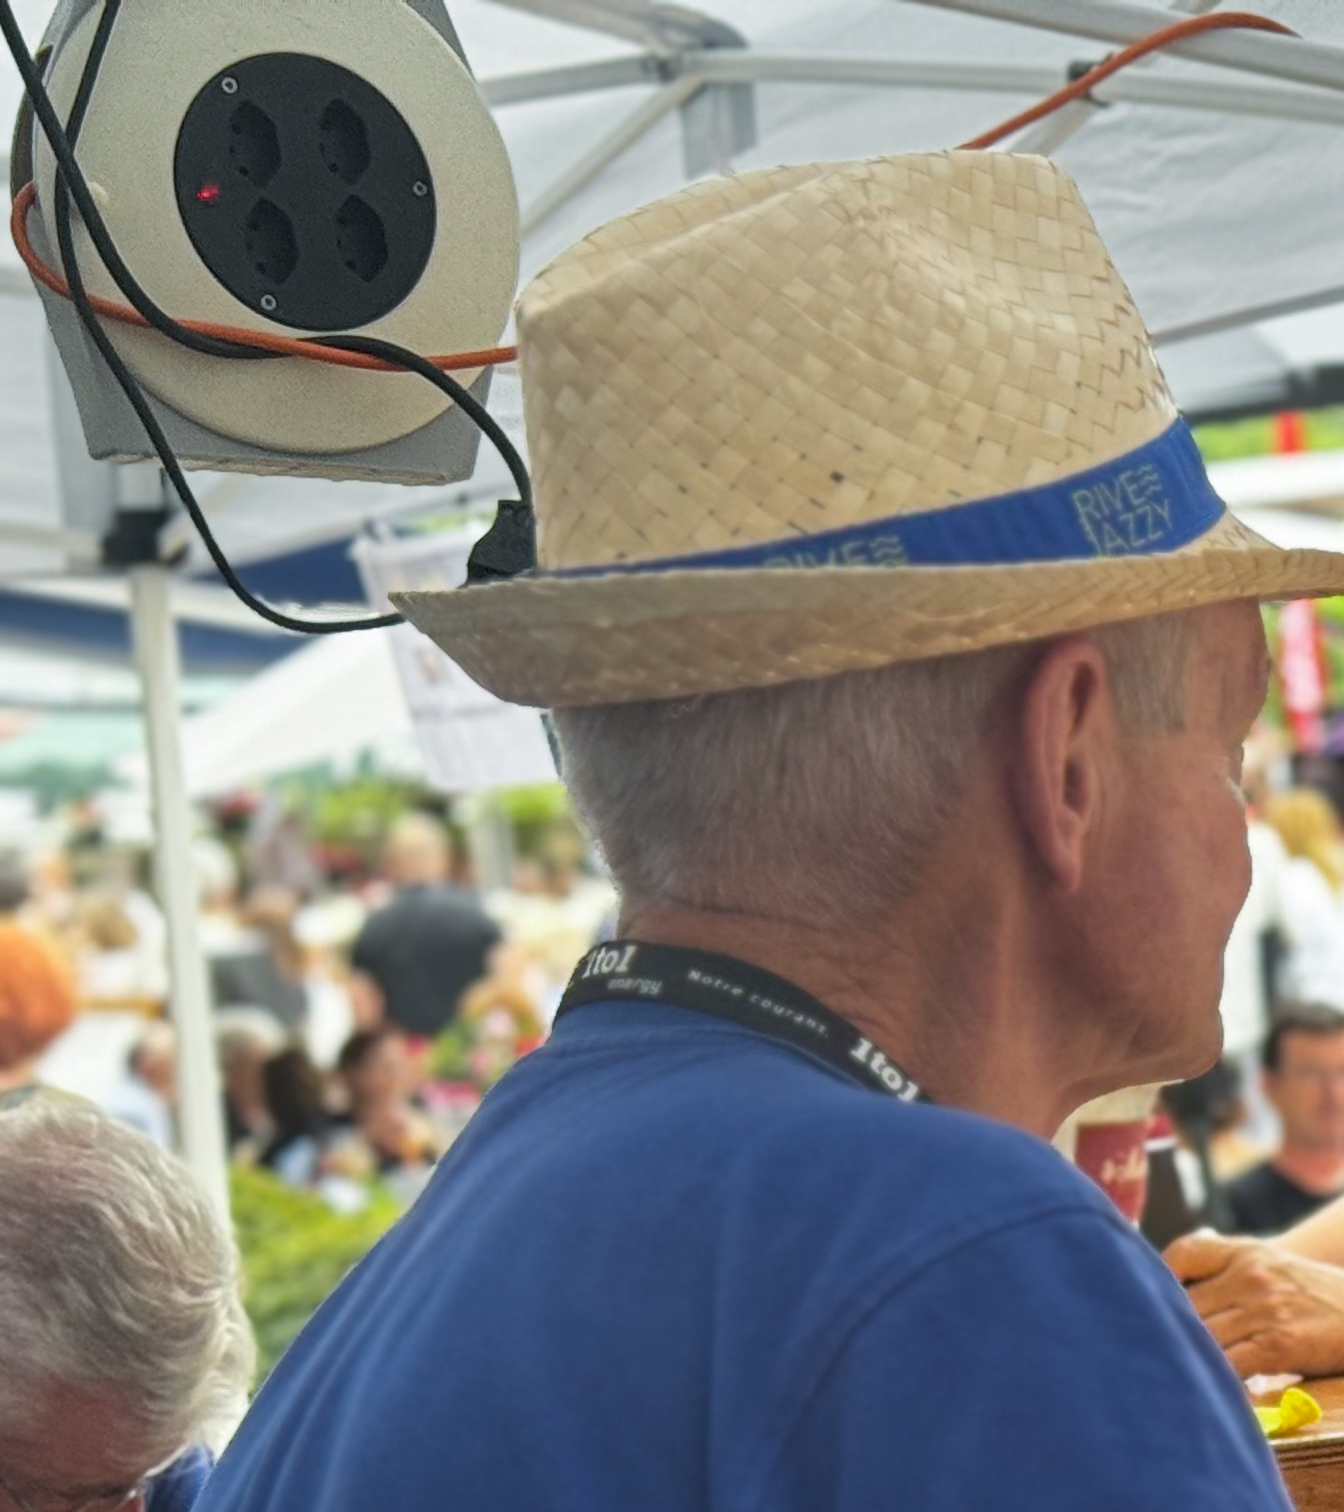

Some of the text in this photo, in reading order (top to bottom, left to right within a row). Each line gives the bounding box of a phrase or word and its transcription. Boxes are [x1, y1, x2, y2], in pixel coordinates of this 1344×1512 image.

[1072, 470, 1145, 522] RIVE
[607, 978, 662, 996] energy
[688, 968, 744, 996] Notre
